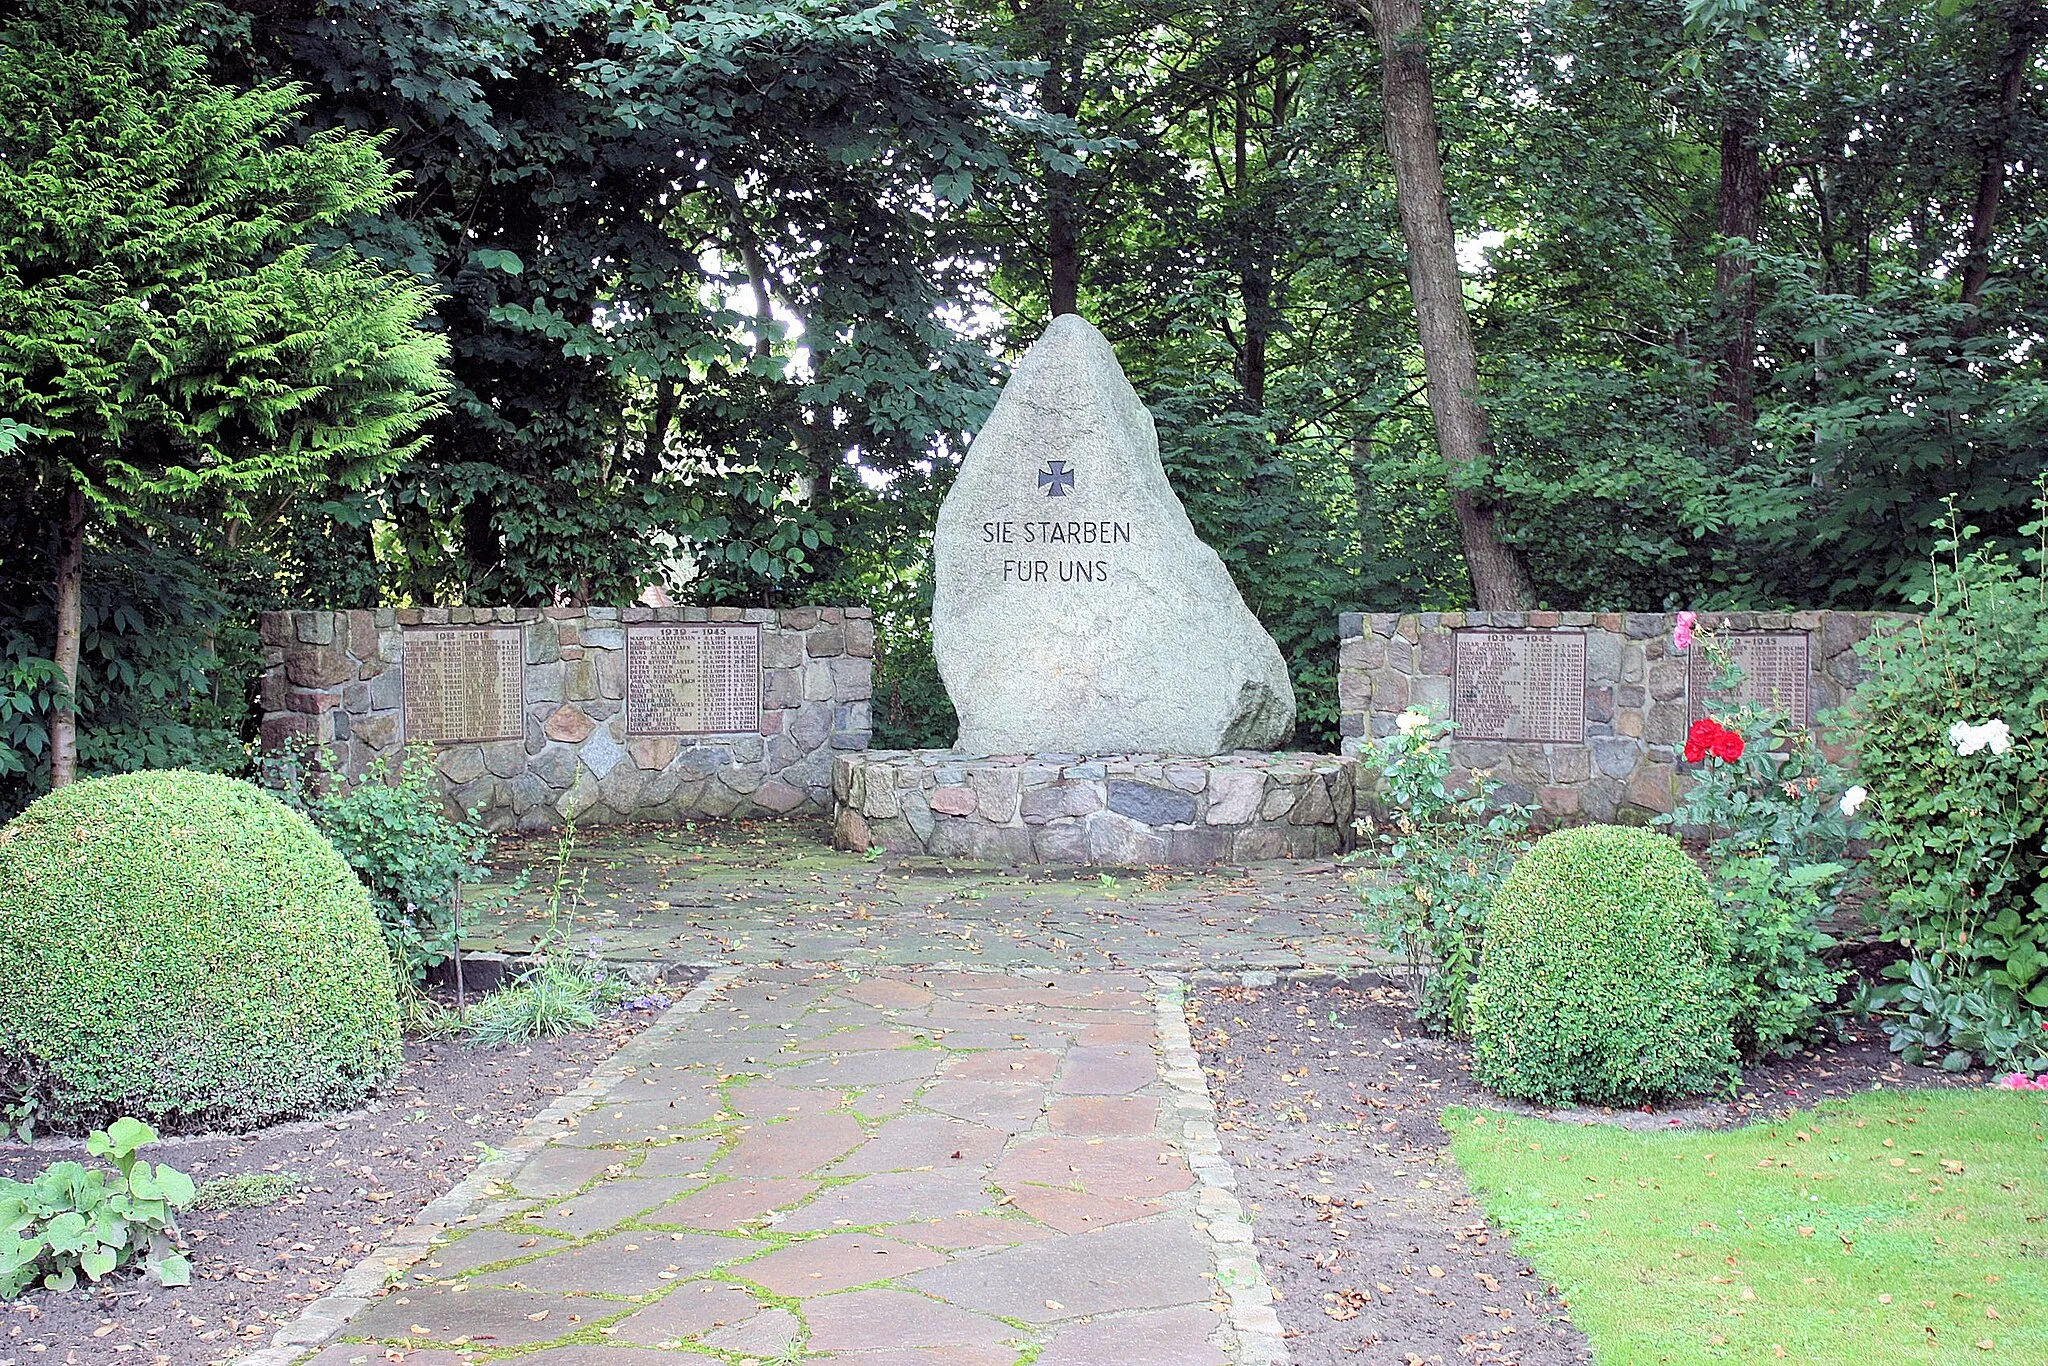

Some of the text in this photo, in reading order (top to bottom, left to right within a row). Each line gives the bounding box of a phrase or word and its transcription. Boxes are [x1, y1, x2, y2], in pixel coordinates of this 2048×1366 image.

[983, 522, 1130, 544] SIE STARBEN
[1004, 560, 1108, 582] FÜR UNS
